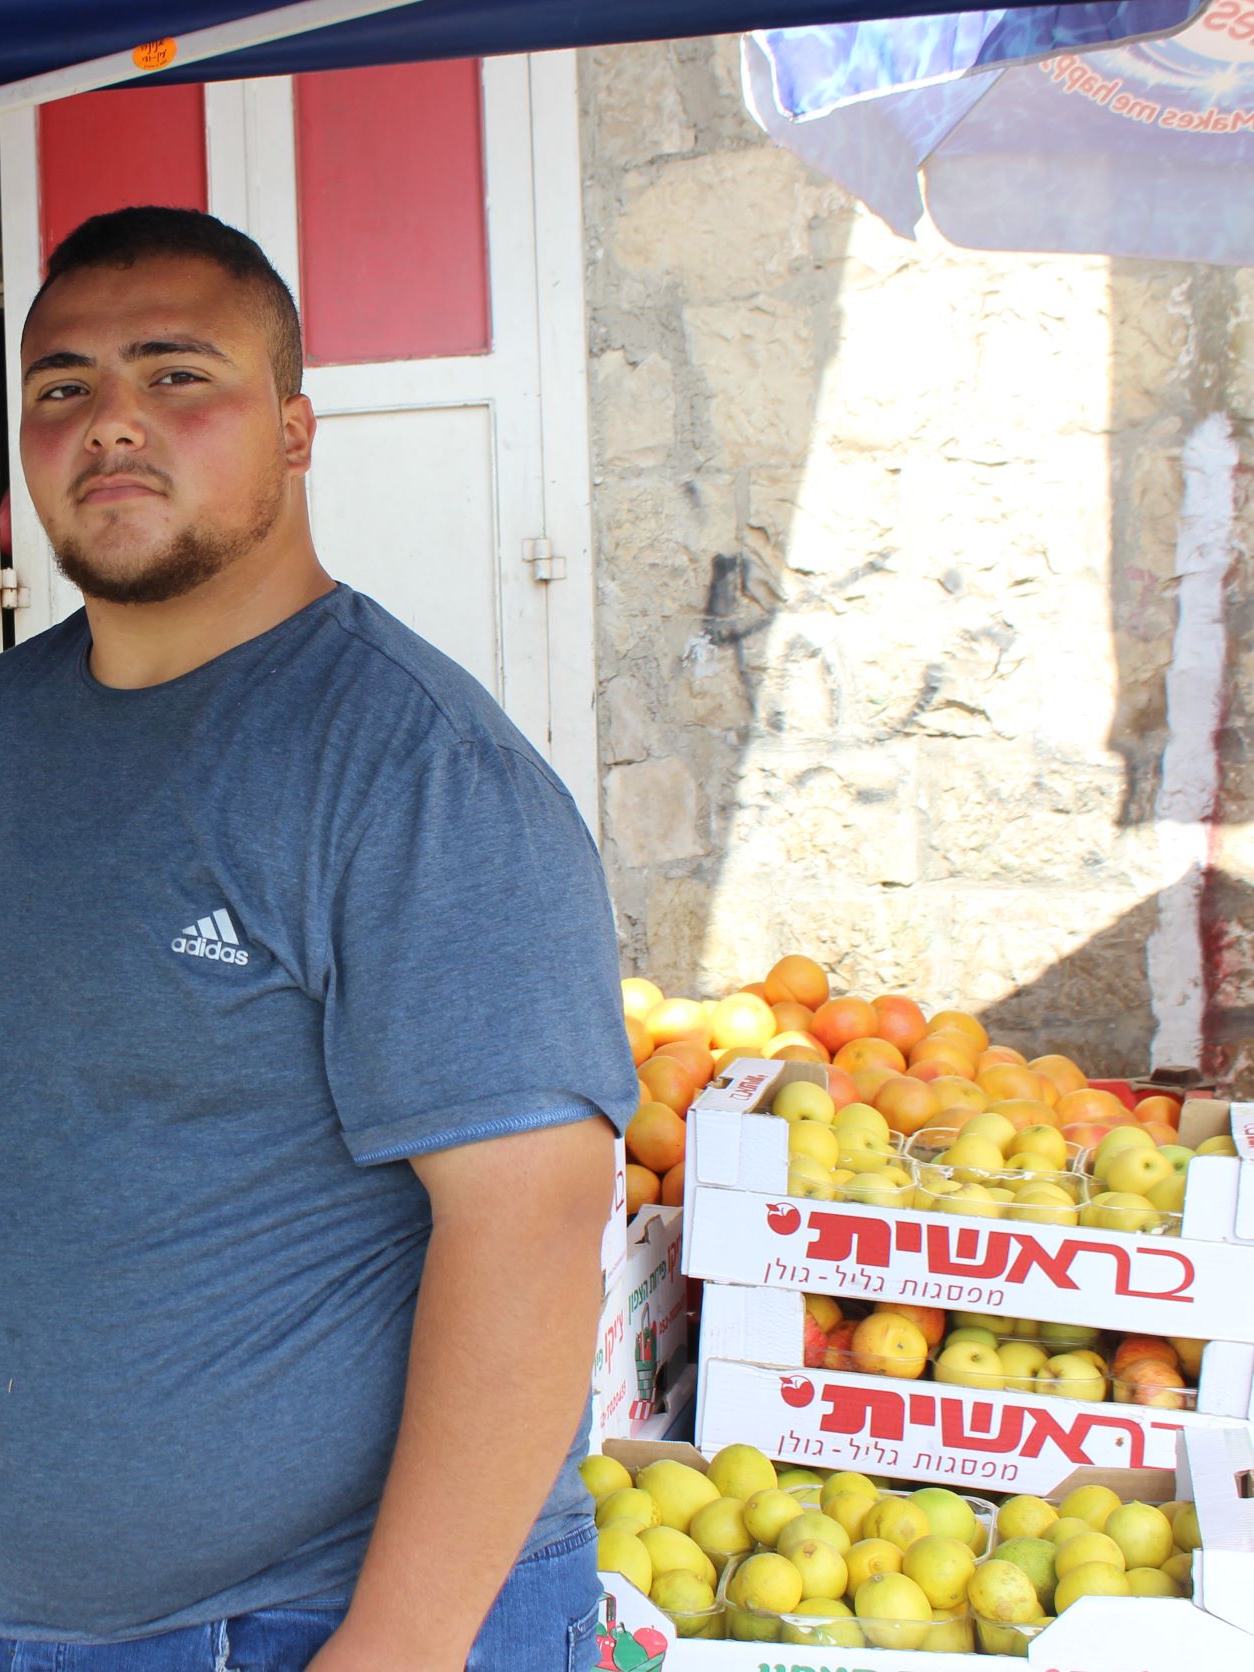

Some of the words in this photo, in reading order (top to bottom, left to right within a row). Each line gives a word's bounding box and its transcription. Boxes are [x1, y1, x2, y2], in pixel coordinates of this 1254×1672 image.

[171, 937, 249, 966] adidas
[806, 1211, 1195, 1303] בראשית
[899, 1279, 1004, 1306] מפסגות
[913, 1452, 1018, 1481] מפסגות
